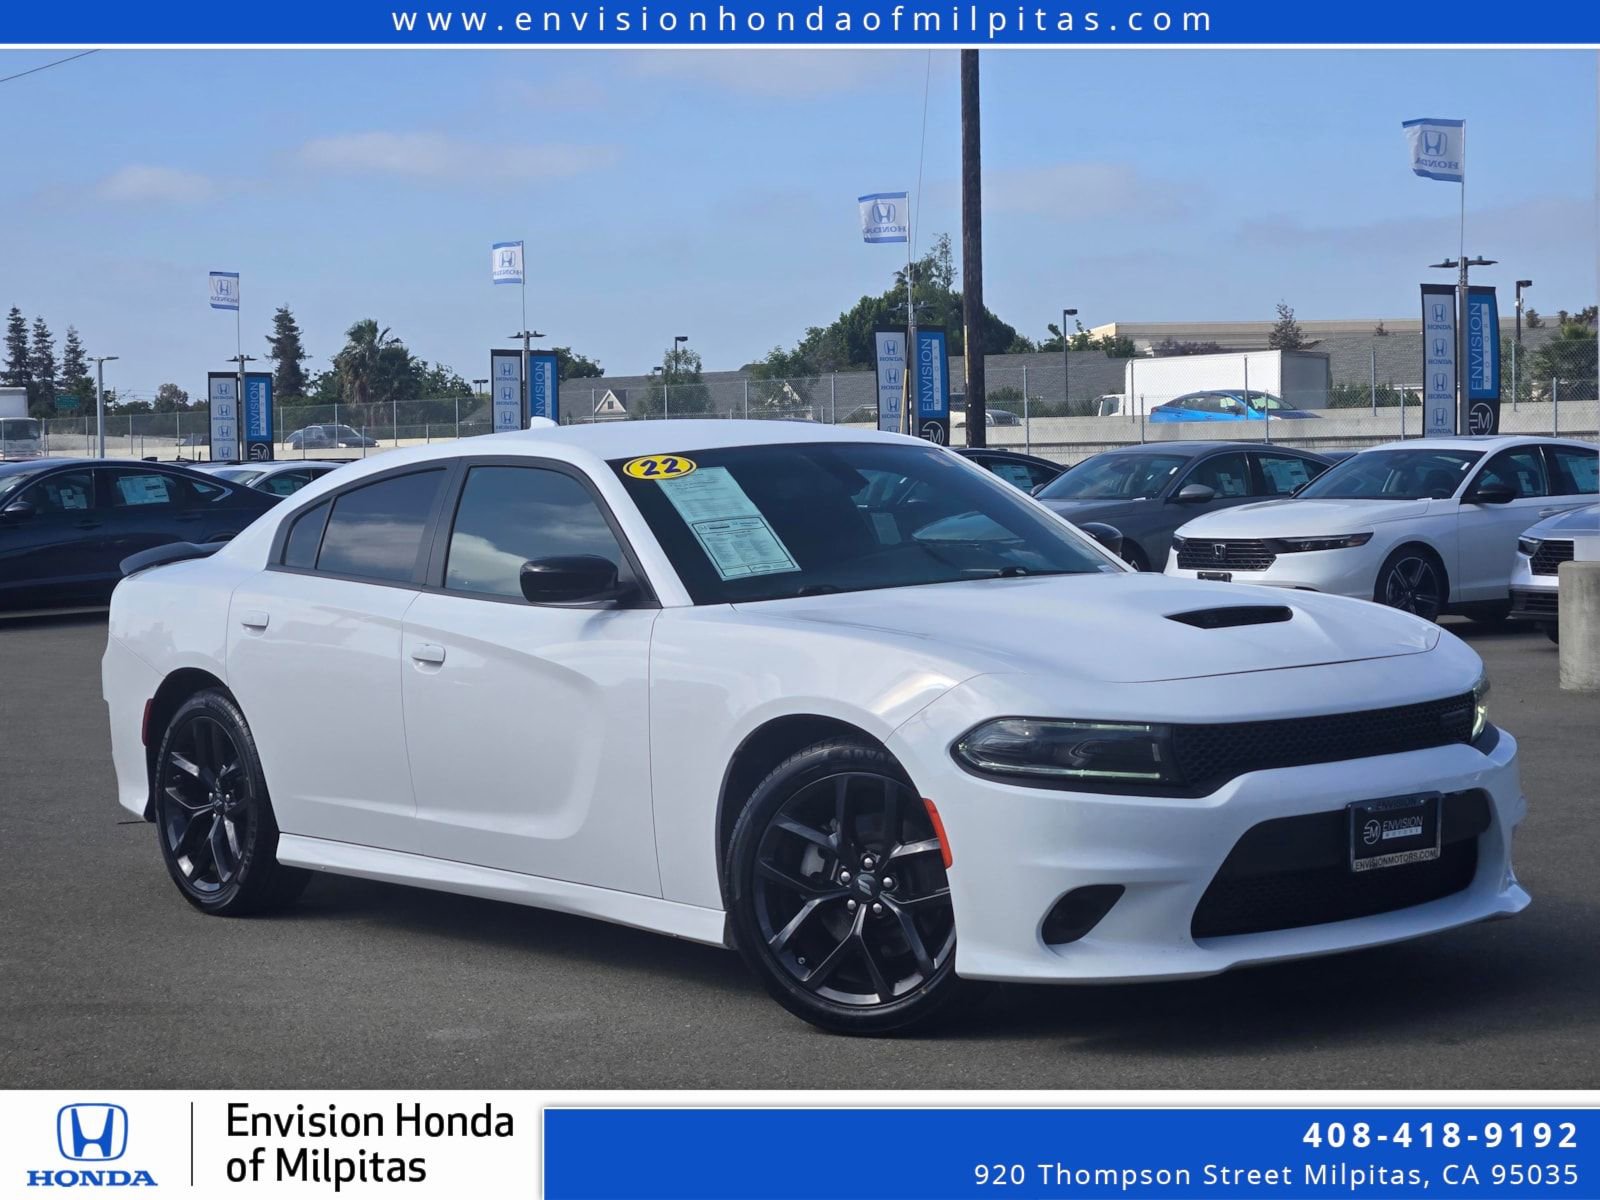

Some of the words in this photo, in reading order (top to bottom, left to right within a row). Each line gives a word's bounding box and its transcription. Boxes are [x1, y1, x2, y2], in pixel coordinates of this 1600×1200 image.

[1469, 302, 1483, 391] ENVISION
[535, 361, 545, 416] NVISION
[921, 338, 934, 411] ENVISION
[251, 381, 260, 436] ENVISION
[640, 457, 682, 476] 22
[1382, 816, 1424, 832] ENVISION
[1355, 850, 1437, 871] ENVISIONMOTORS.COM
